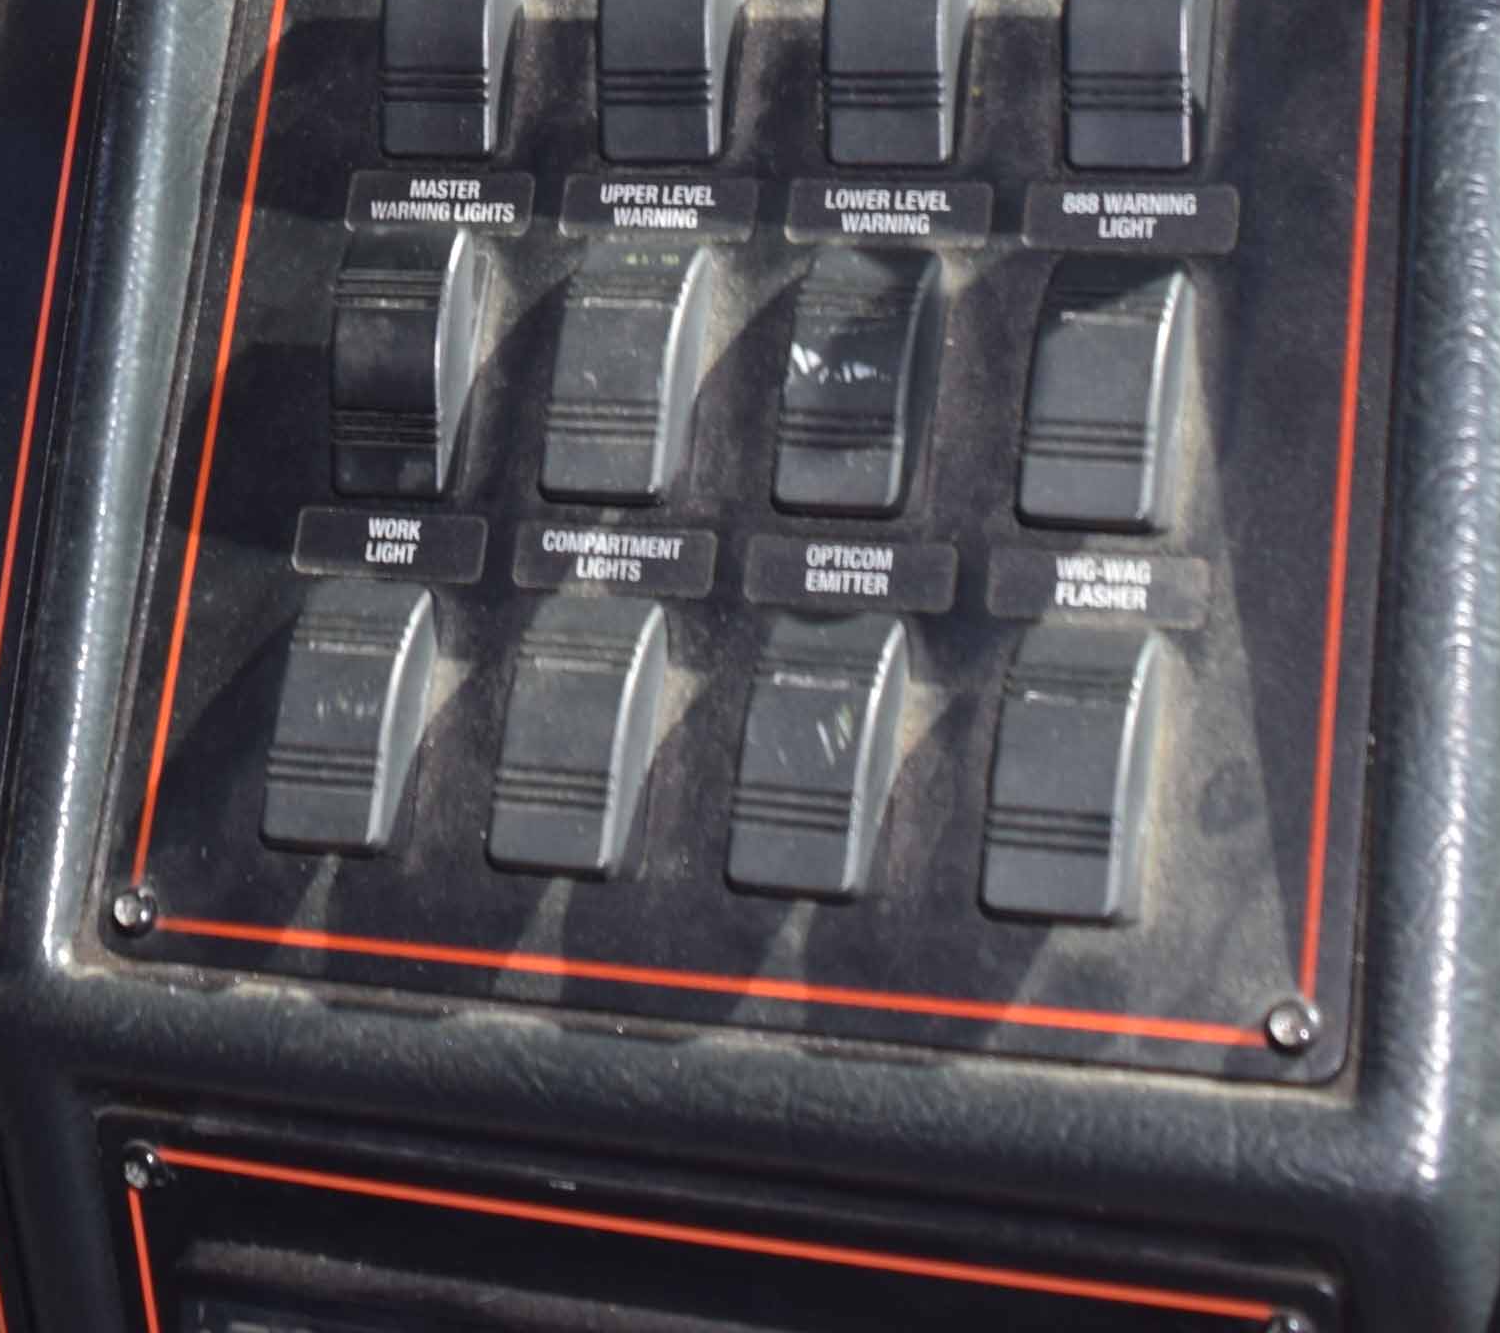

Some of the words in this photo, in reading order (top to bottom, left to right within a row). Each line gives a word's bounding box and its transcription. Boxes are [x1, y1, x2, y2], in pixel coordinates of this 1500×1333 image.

[409, 179, 481, 200] MASTER
[600, 183, 659, 205] UPPER
[662, 185, 716, 207] LEVEL
[824, 189, 891, 211] LOWER
[894, 190, 951, 212] LEVEL
[370, 201, 451, 222] WARNING
[453, 202, 515, 224] LIGHTS
[1103, 193, 1198, 216] WARNING
[613, 207, 698, 229] WARNING
[841, 213, 930, 235] WARNING
[1098, 217, 1158, 239] LIGHT
[368, 517, 422, 541] WORK
[365, 541, 418, 565] LIGHT
[542, 529, 684, 561] COMPARTMENT
[805, 543, 893, 570] OPTICOM
[575, 556, 642, 582] LIGHTS
[1055, 556, 1152, 584] WIG-WAG
[804, 569, 889, 596] EMITTER
[1054, 581, 1148, 612] FLASHER
